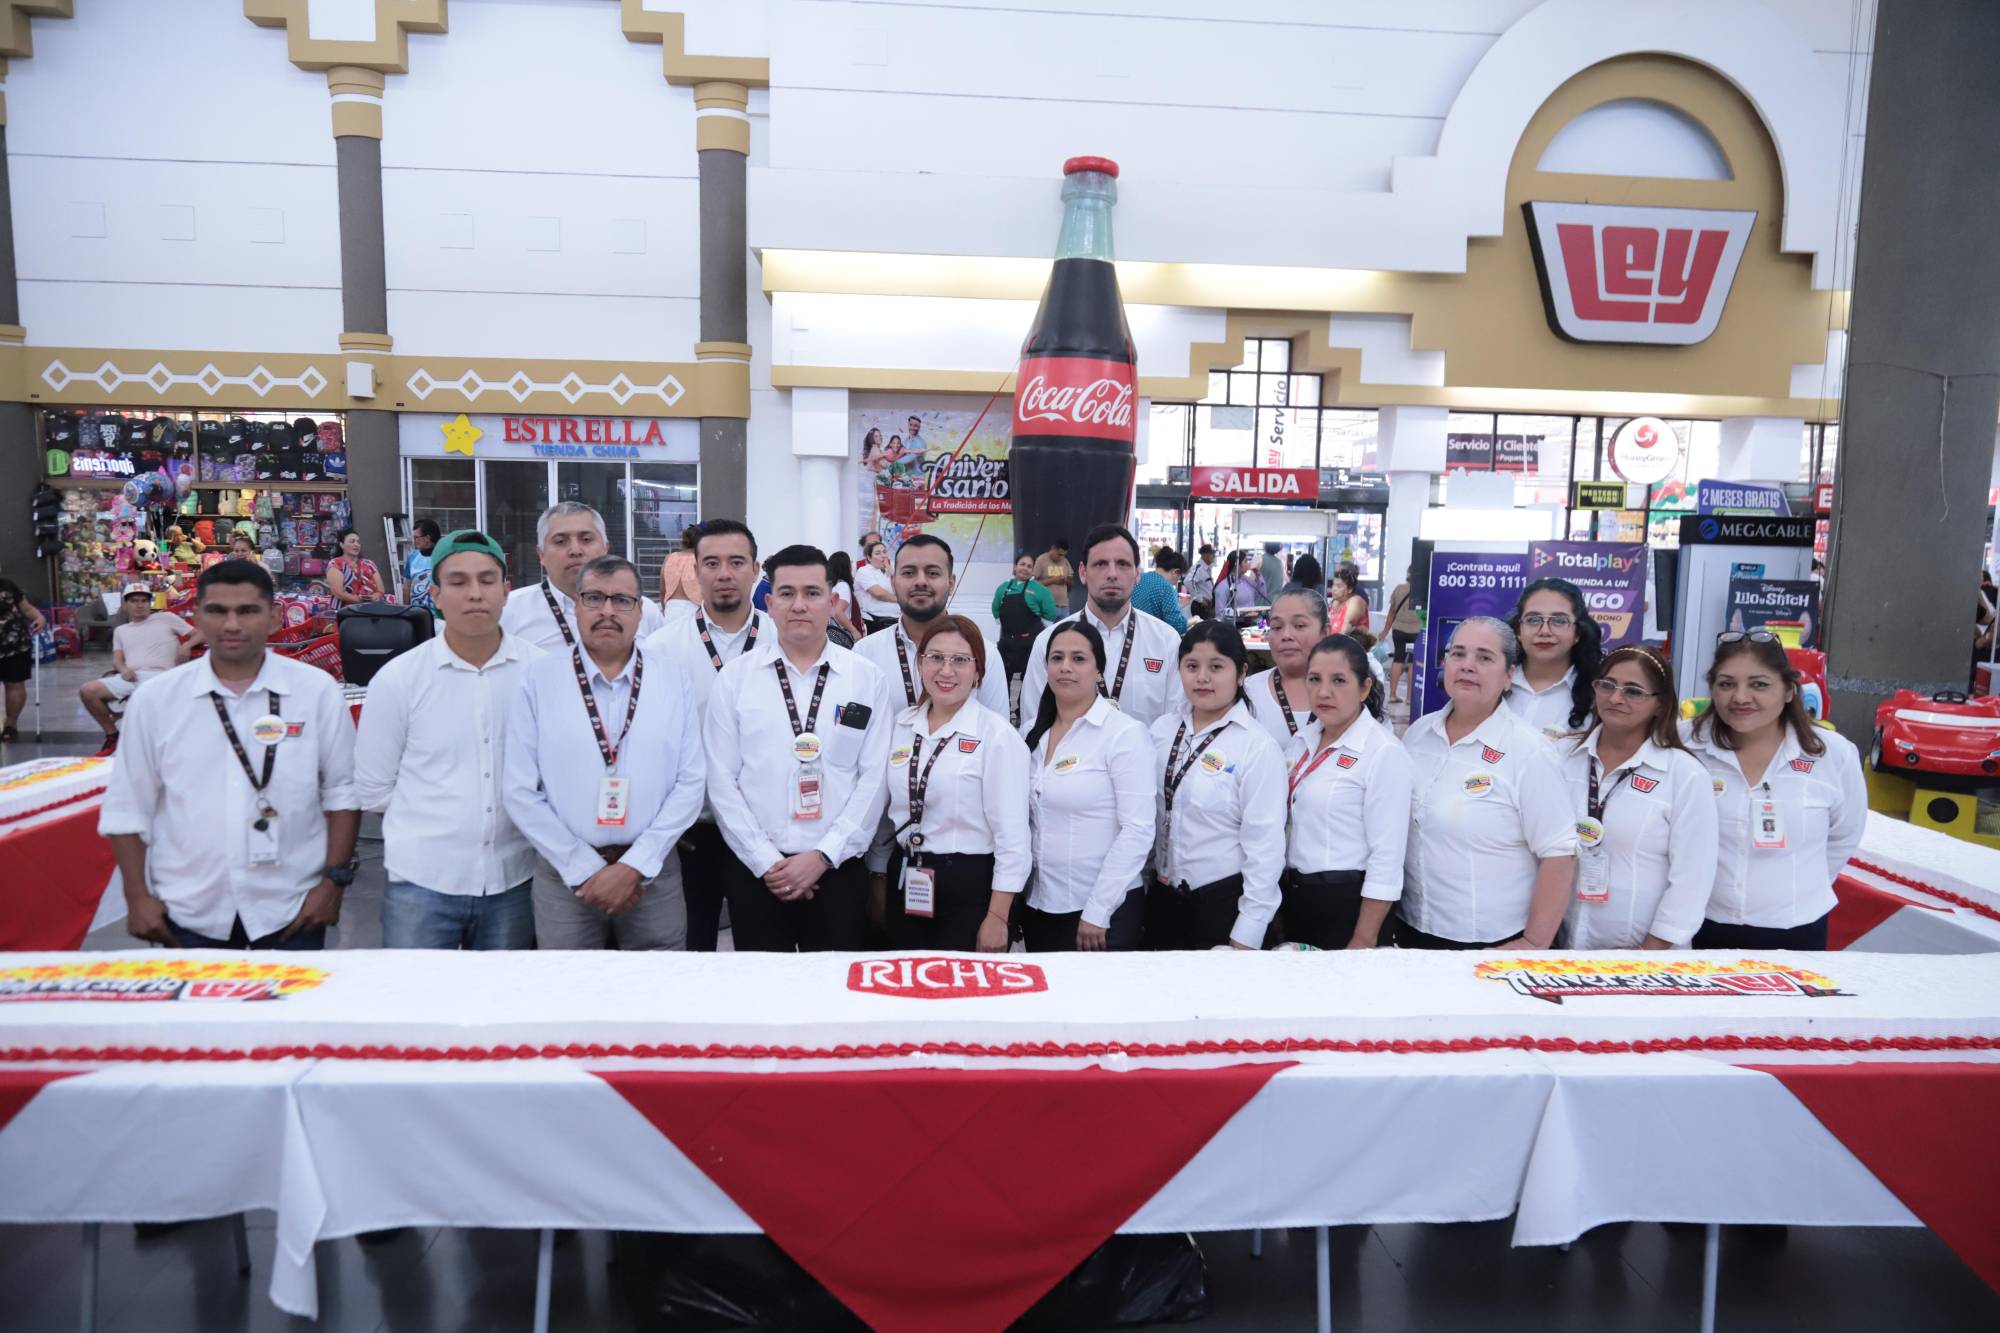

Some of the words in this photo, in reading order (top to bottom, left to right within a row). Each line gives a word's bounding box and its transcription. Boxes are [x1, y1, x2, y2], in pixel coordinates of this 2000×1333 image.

[1019, 375, 1133, 427] Coca-Cola
[502, 416, 667, 446] ESTRELLA
[531, 444, 588, 457] TIENDA
[592, 445, 641, 458] CHINA
[1448, 439, 1490, 451] Servicio
[1209, 472, 1300, 494] SALIDA
[1581, 490, 1618, 498] WESTERN
[1702, 488, 1709, 506] 2
[1710, 489, 1743, 508] MESES
[1744, 491, 1780, 509] GRATIS
[932, 501, 942, 509] La
[943, 501, 977, 510] Tradición
[988, 502, 1000, 510] los
[1720, 523, 1812, 538] MEGACABLE
[1447, 562, 1494, 573] ¡Contrata
[1556, 552, 1633, 573] Totalplay
[1047, 566, 1065, 577] CAT
[1438, 575, 1467, 588] 800
[1468, 576, 1497, 588] 330
[1499, 575, 1527, 589] 1111
[1605, 580, 1613, 588] A
[1614, 580, 1630, 588] UN
[859, 960, 1035, 989] RICH'S
